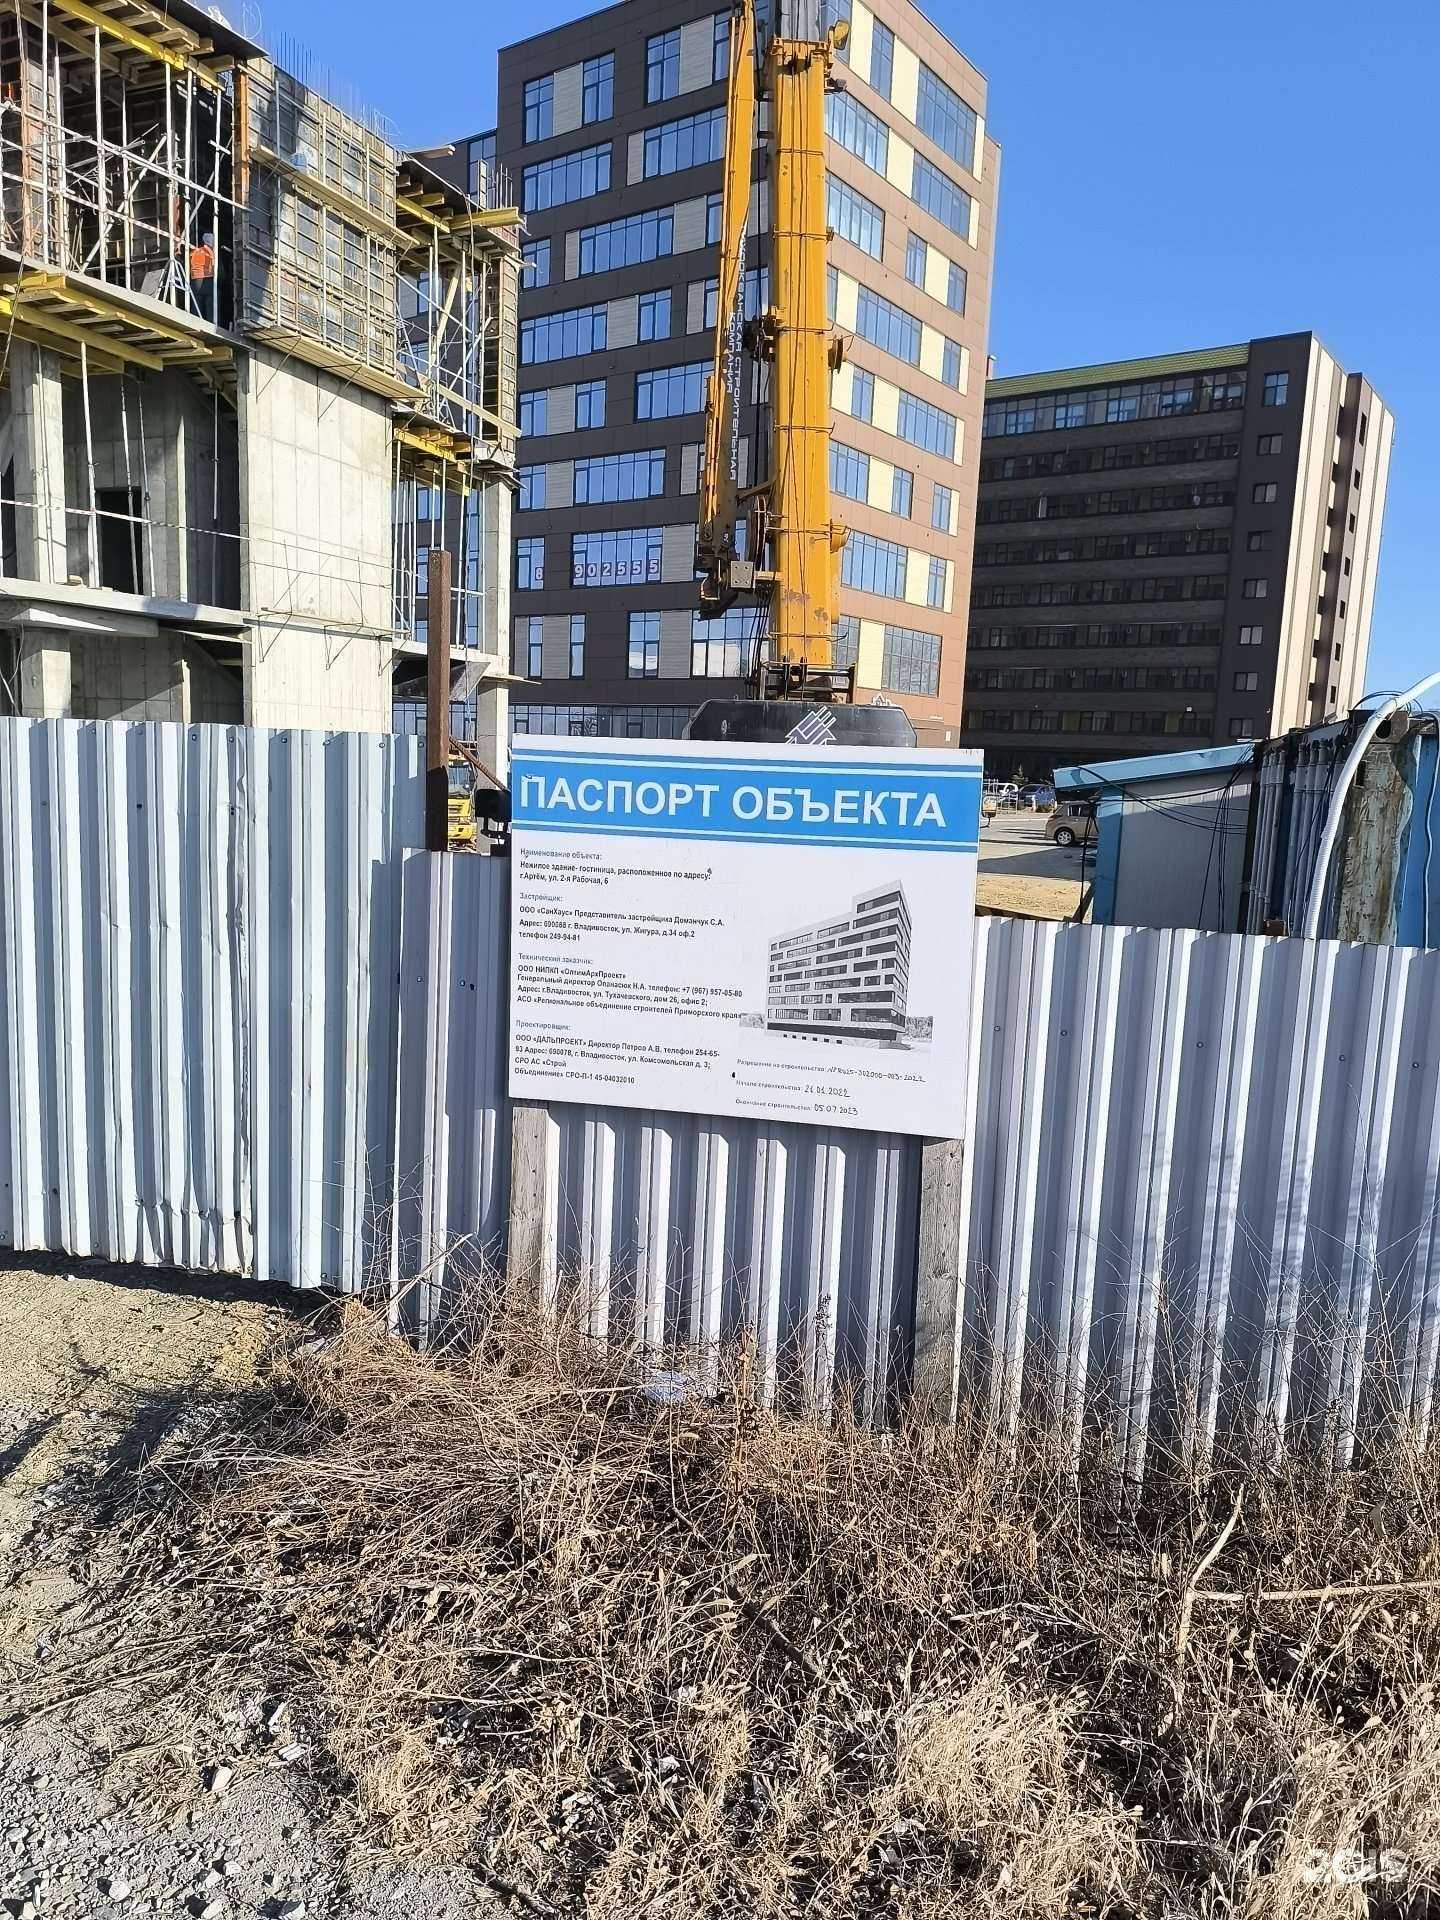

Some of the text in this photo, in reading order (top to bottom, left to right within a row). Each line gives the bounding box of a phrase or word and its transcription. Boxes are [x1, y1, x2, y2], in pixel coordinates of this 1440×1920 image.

[726, 312, 736, 394] КОМПАНИЯ
[729, 222, 748, 481] ХООКЕАНСКАЯ СТРОИТЕЛЬНАЯ
[520, 774, 947, 827] ПАСПОРТ ОБЪЕКТА
[519, 872, 547, 882] г.Артём,
[560, 874, 571, 882] 2-я
[572, 875, 603, 885] Рабочая,
[520, 861, 550, 870] Нежилое
[551, 864, 578, 872] здание-
[579, 866, 616, 875] гостиница,
[617, 868, 672, 878] расположенное
[683, 872, 711, 881] адресу:
[537, 907, 572, 917] «СанХаус»
[574, 909, 627, 920] Представитель
[627, 914, 673, 923] застройщика
[710, 918, 725, 926] С.А.
[518, 931, 580, 941] телефон 249-94-81
[519, 919, 542, 928] Адрес:
[574, 923, 620, 933] Владивосток,
[633, 927, 661, 936] Жигура,
[678, 930, 695, 938] оф.2
[517, 974, 563, 983] Генеральный
[563, 979, 595, 987] директор
[597, 980, 632, 989] Опанасюк
[632, 982, 647, 990] Н.А.
[648, 984, 681, 993] телефон:
[517, 985, 541, 993] Адрес:
[542, 987, 592, 998] г.Владивосток,
[605, 991, 653, 1002] Тухачевского,
[653, 995, 668, 1003] дом
[681, 997, 700, 1005] офис
[701, 998, 708, 1006] 2;
[534, 997, 585, 1007] «Региональное
[585, 1001, 632, 1010] объединение
[633, 1005, 673, 1014] строителей
[674, 1007, 721, 1017] Приморского
[533, 1035, 586, 1046] «ДАЛЬПРОЕКТ»
[587, 1040, 620, 1050] Директор
[621, 1043, 647, 1052] Петров
[663, 1047, 694, 1056] телефон
[524, 1046, 547, 1055] Адрес:
[580, 1051, 627, 1062] Владивосток,
[628, 1055, 639, 1063] ул.
[639, 1055, 694, 1067] Комсомольская
[530, 1057, 541, 1065] АС
[542, 1059, 567, 1067] «Строй
[514, 1067, 564, 1077] Объединение»
